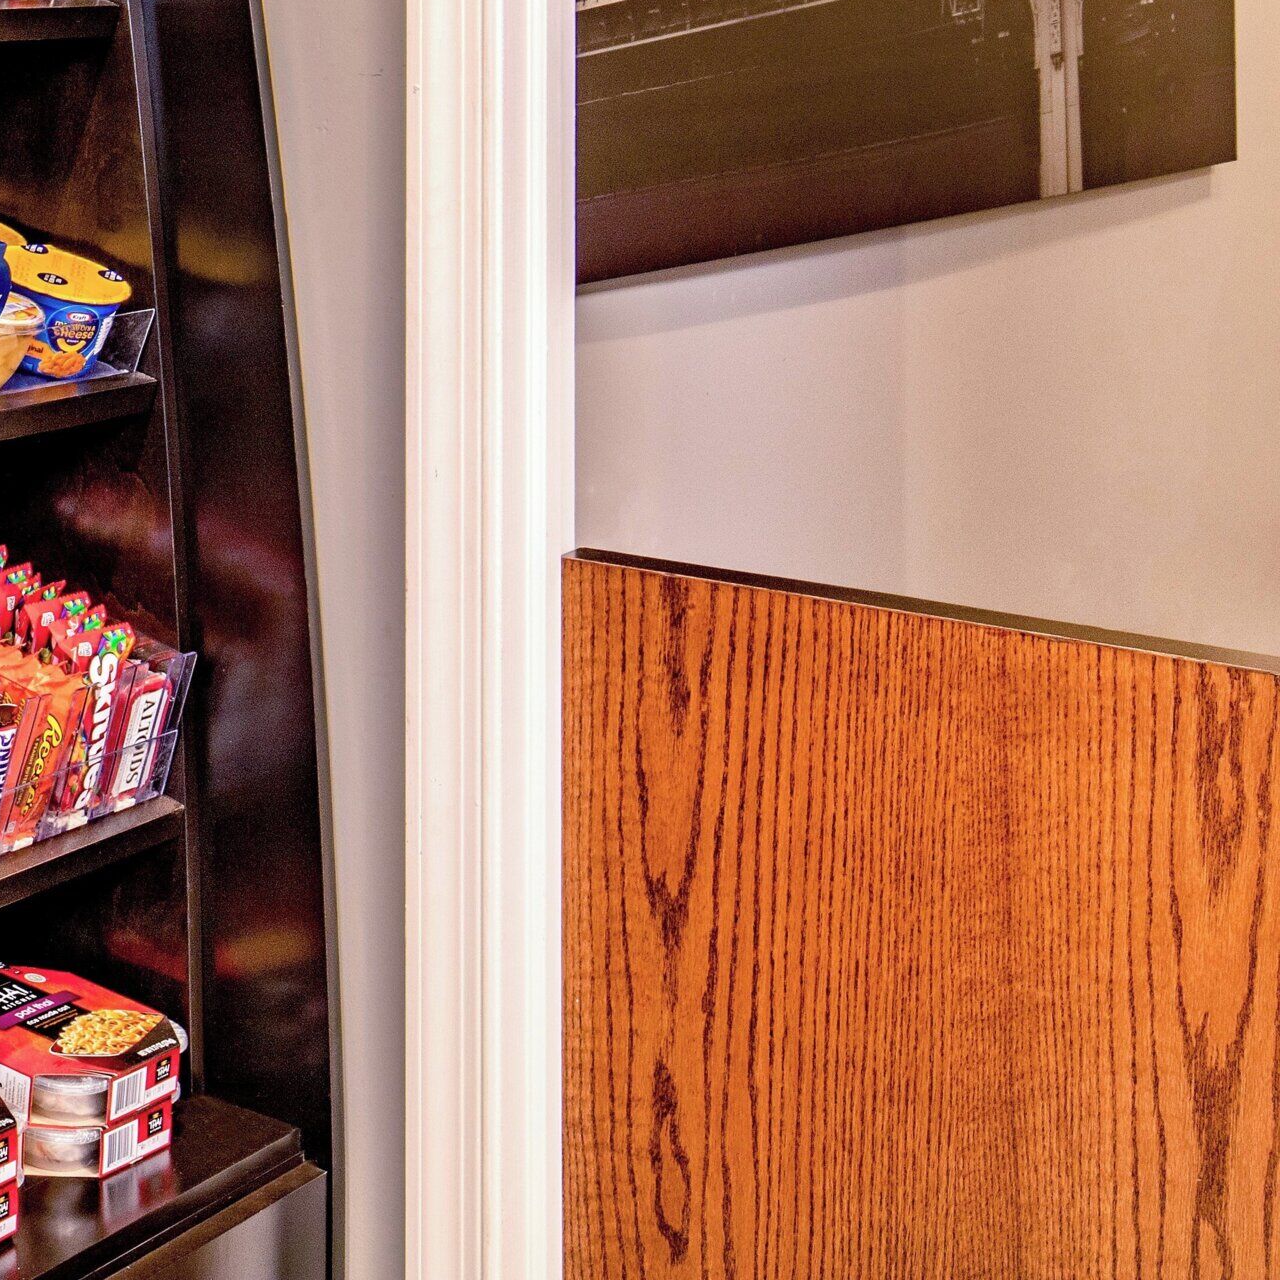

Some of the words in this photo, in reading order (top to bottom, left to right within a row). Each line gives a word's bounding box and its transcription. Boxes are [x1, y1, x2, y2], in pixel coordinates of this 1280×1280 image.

[71, 313, 88, 321] Kraft
[73, 653, 118, 810] Skittles
[126, 700, 157, 784] ALTOIDS
[2, 994, 37, 1011] KITCHEN
[17, 1006, 35, 1019] pad
[36, 998, 55, 1013] thai
